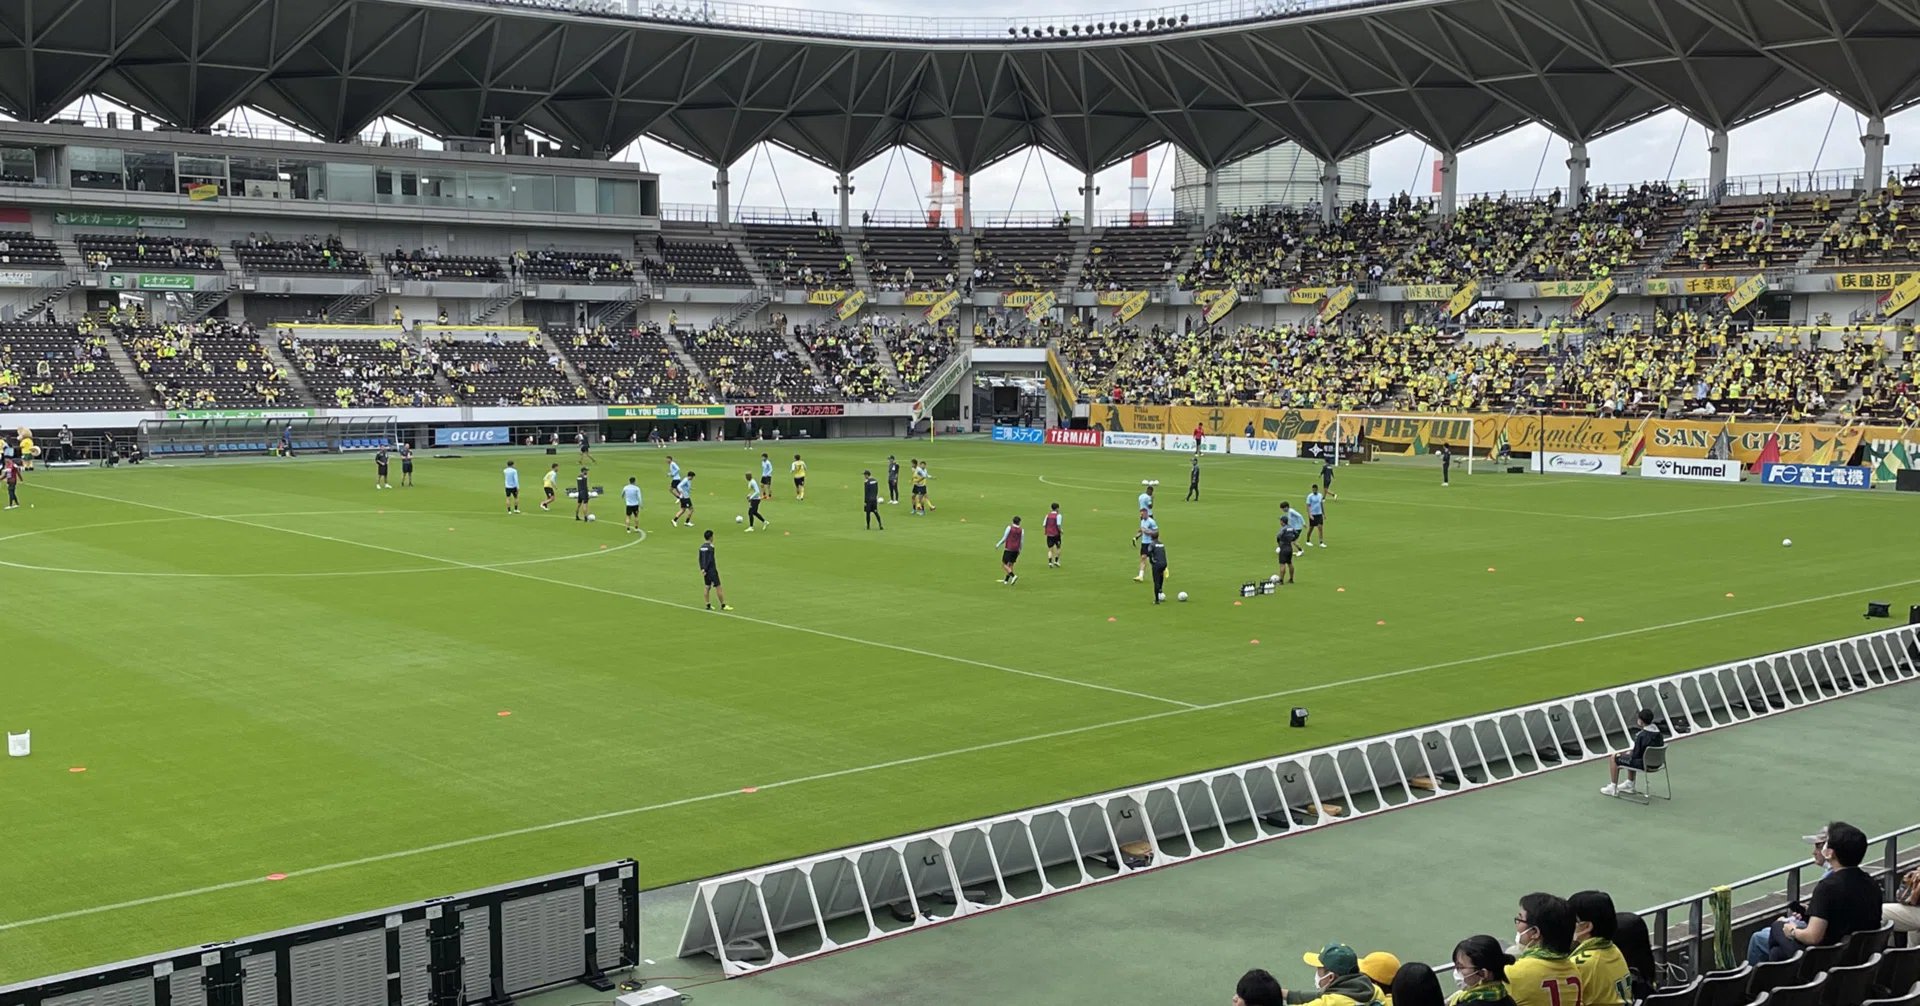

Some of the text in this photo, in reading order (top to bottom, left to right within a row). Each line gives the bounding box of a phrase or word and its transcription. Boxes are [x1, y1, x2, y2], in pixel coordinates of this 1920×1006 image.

[69, 212, 138, 225] レオガーデン
[144, 275, 190, 285] レオガーデン
[625, 407, 709, 416] ALL YOU NEED IS FOOTBALL
[451, 429, 494, 441] acure
[1365, 418, 1470, 440] PASON
[1509, 416, 1606, 446] Familia
[1051, 430, 1097, 445] TERMINA
[1655, 427, 1709, 448] SAN
[1248, 439, 1278, 452] view
[1673, 462, 1726, 477] hummel
[1800, 468, 1864, 486] 富士電機
